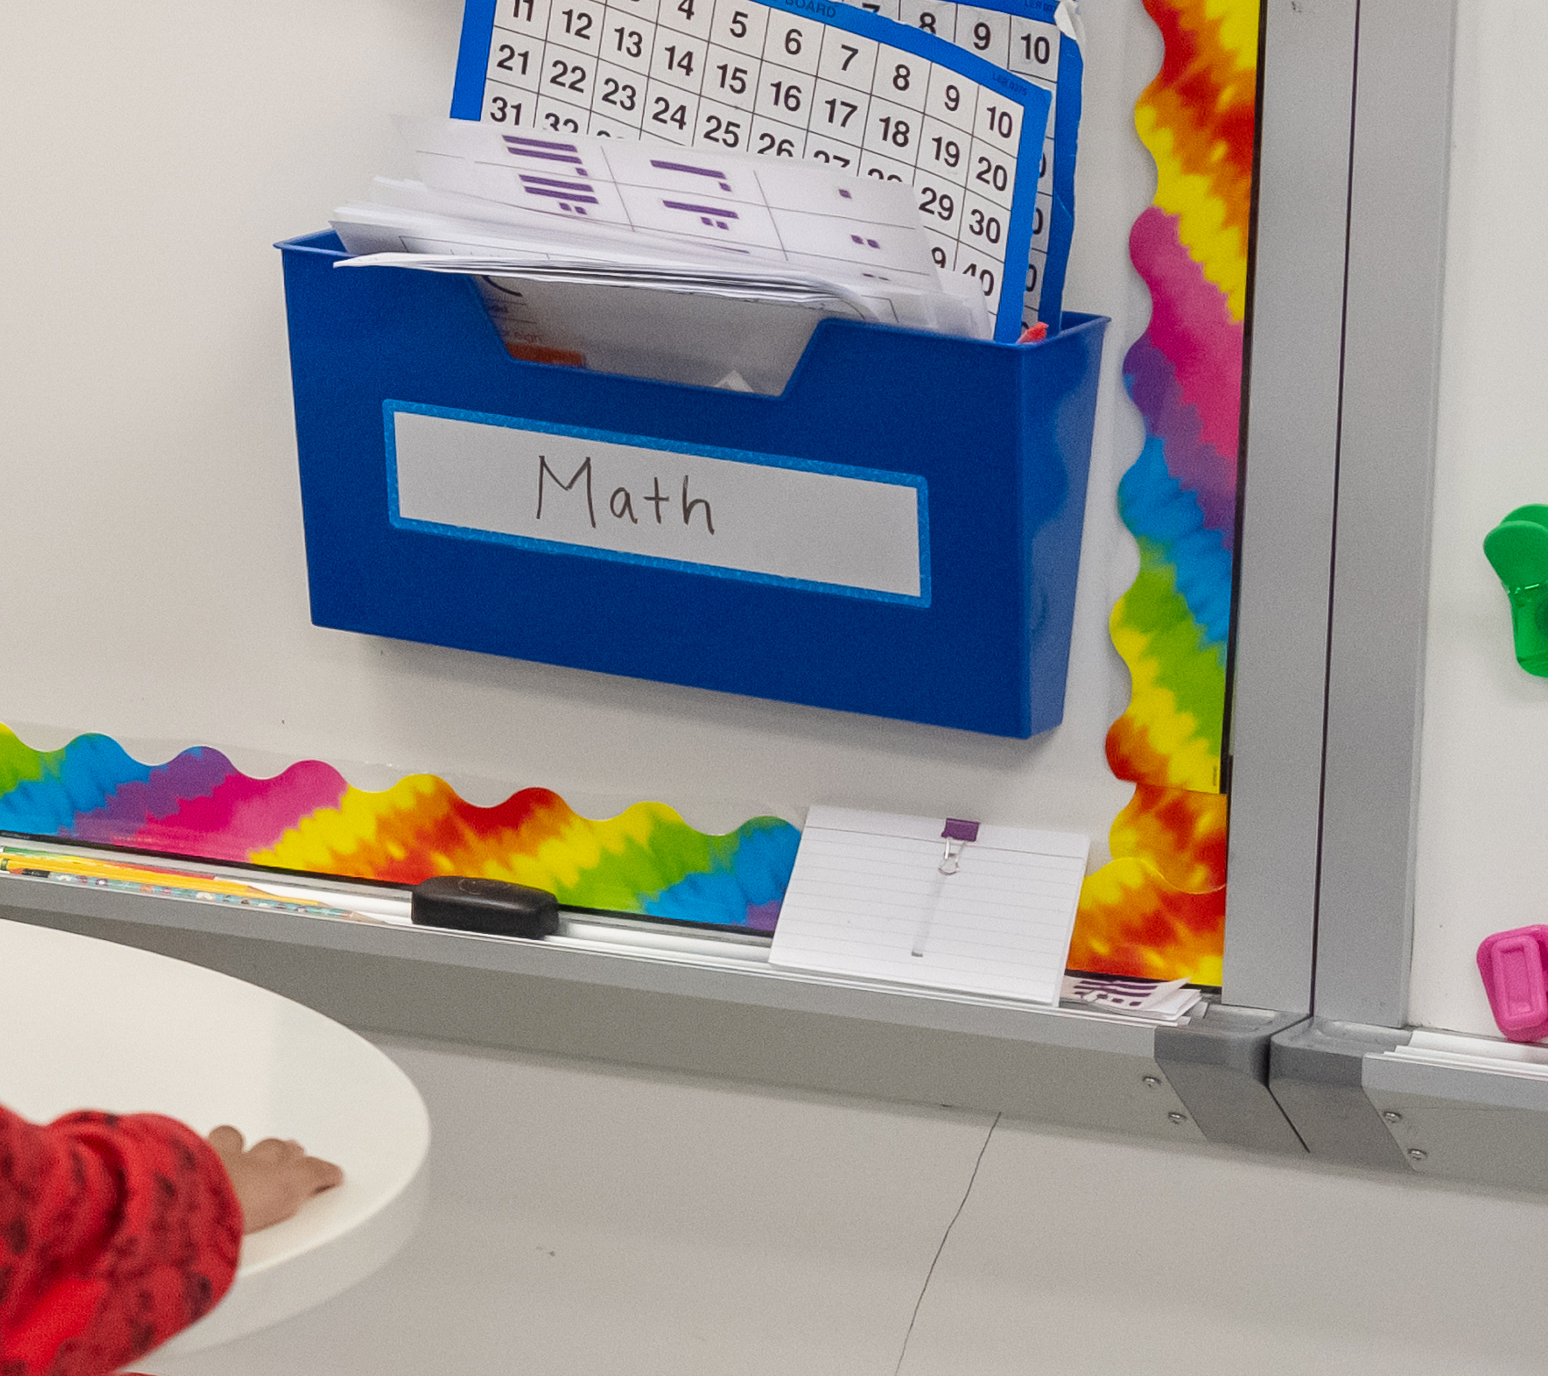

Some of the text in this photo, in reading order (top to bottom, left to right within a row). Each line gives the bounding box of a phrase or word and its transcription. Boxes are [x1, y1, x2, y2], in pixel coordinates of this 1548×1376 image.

[490, 96, 522, 126] 31
[562, 9, 593, 40] 12
[614, 26, 643, 58] 13
[664, 45, 694, 76] 14
[716, 63, 748, 94] 15
[770, 81, 802, 112] 16
[824, 98, 858, 128] 17
[879, 117, 910, 148] 18
[931, 137, 960, 168] 19
[976, 157, 1008, 192] 20
[730, 11, 748, 38] 5
[785, 28, 802, 56] 6
[841, 45, 858, 72] 7
[892, 64, 911, 91] 8
[945, 85, 960, 112] 9
[987, 106, 1013, 139] 10
[497, 44, 1000, 245] 21 22 23 24 25 29 30
[536, 455, 715, 535] Math
